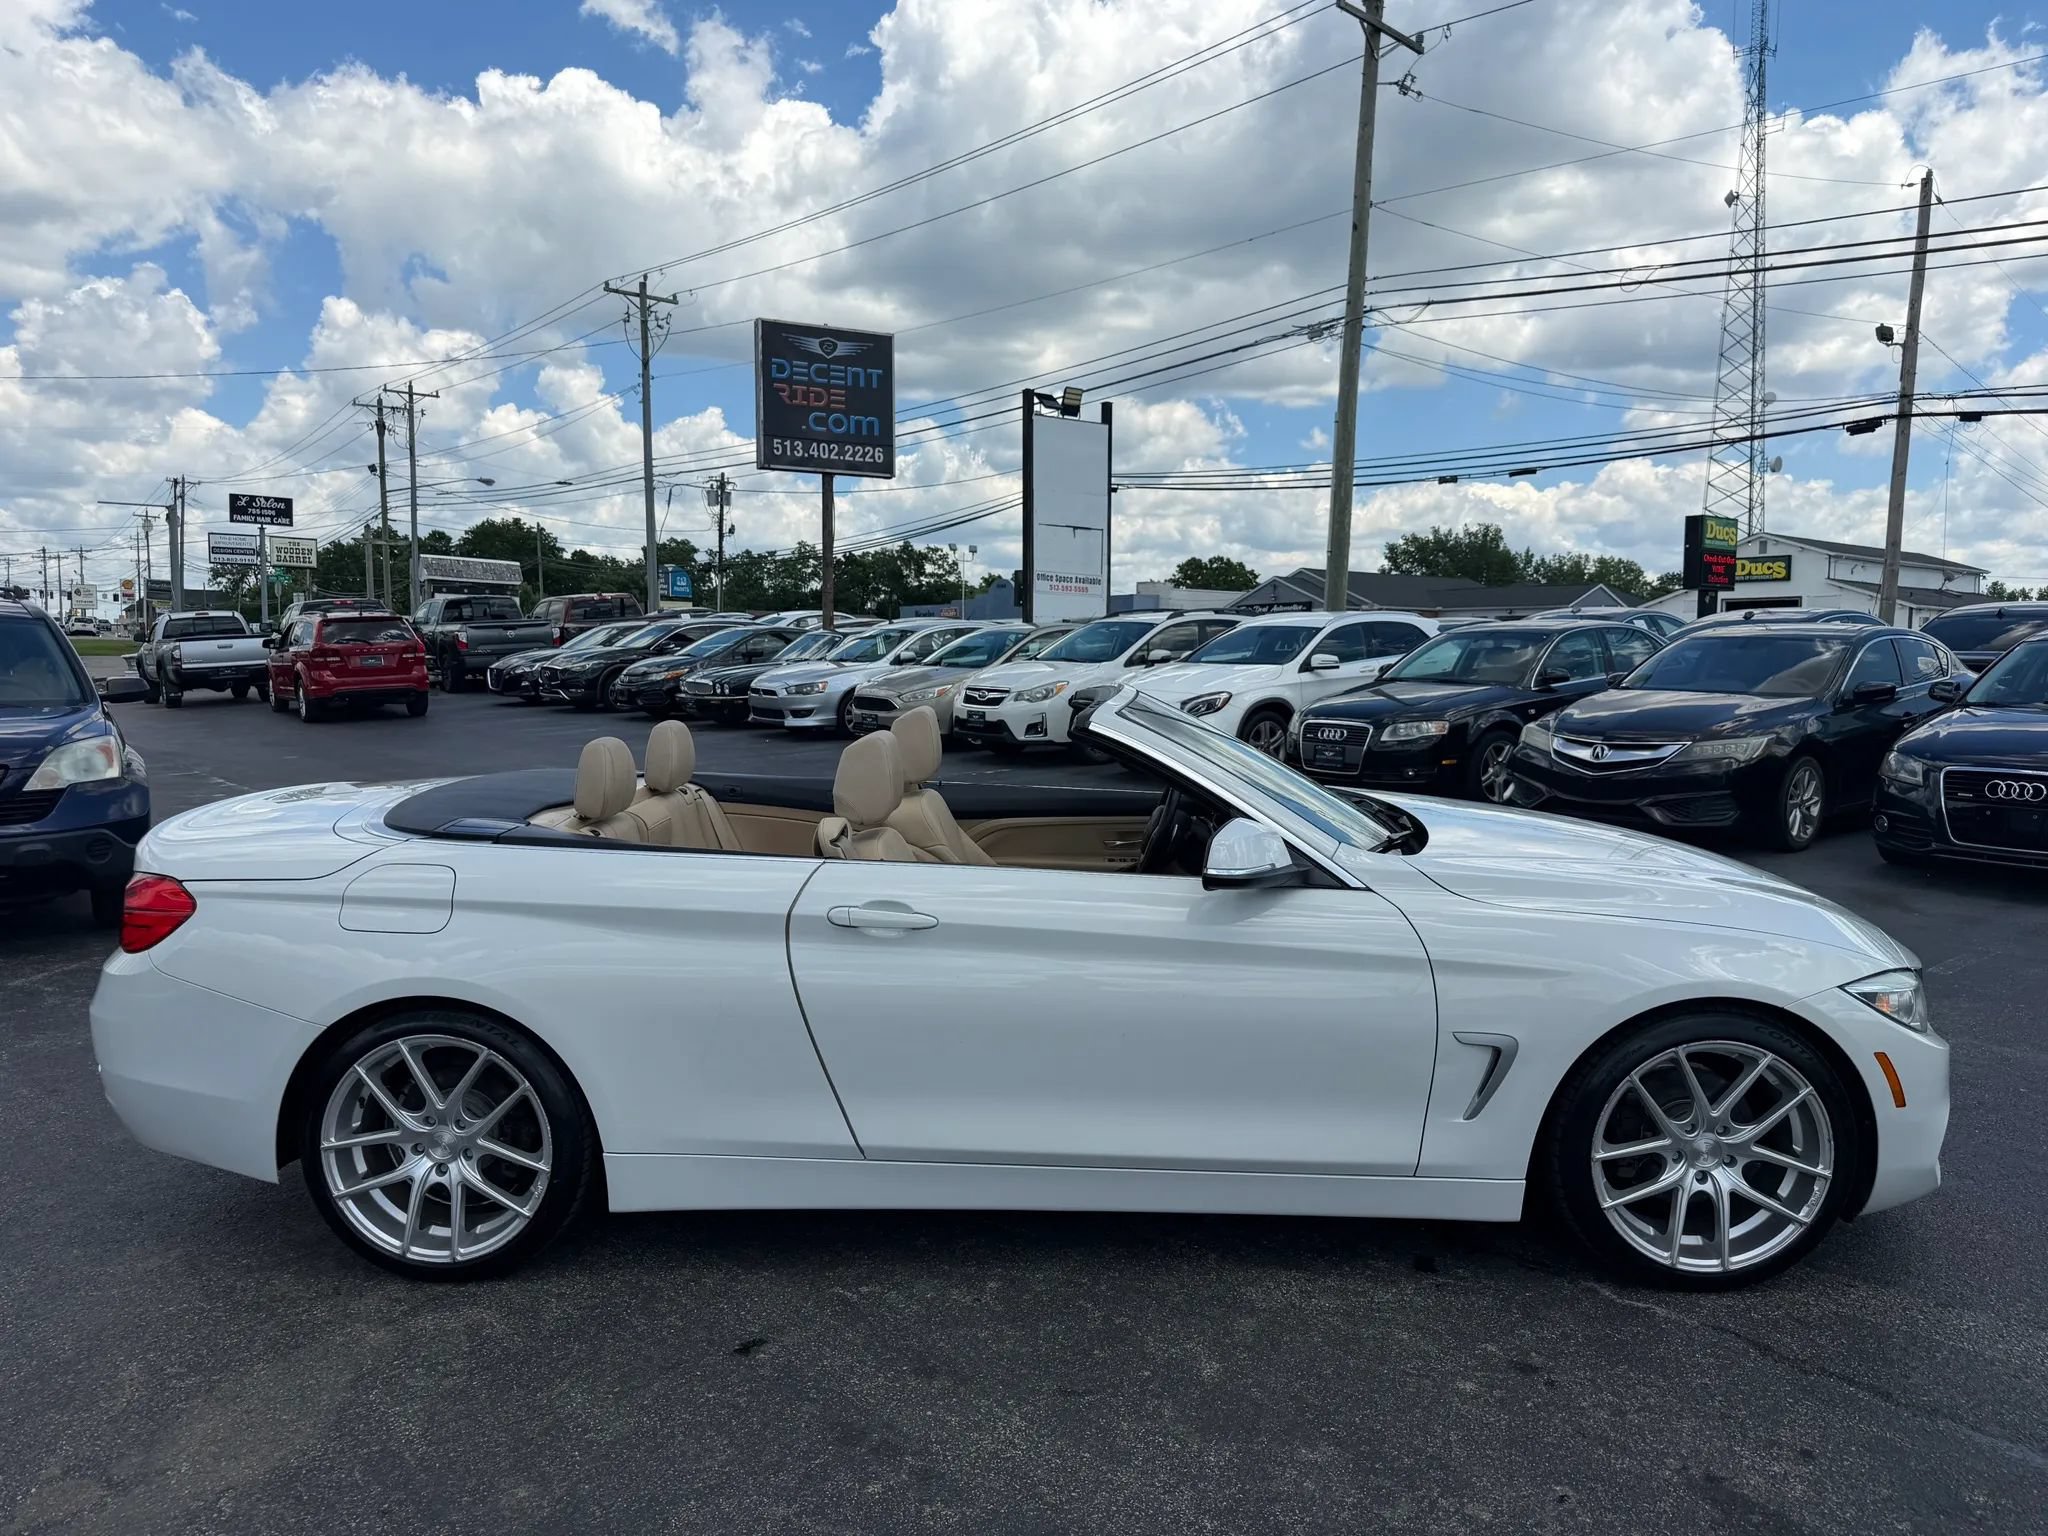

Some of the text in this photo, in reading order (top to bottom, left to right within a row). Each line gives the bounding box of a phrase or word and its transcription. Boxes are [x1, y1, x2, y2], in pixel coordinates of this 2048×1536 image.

[771, 357, 883, 389] DECENT
[773, 383, 846, 409] RIDE
[773, 438, 884, 463] 513.402.2226
[252, 496, 286, 509] Salon
[233, 514, 290, 525] FAMILY HAIR CARE
[275, 546, 313, 556] WOODEN
[275, 554, 313, 564] BARREL
[1036, 573, 1102, 586] Office Space Available
